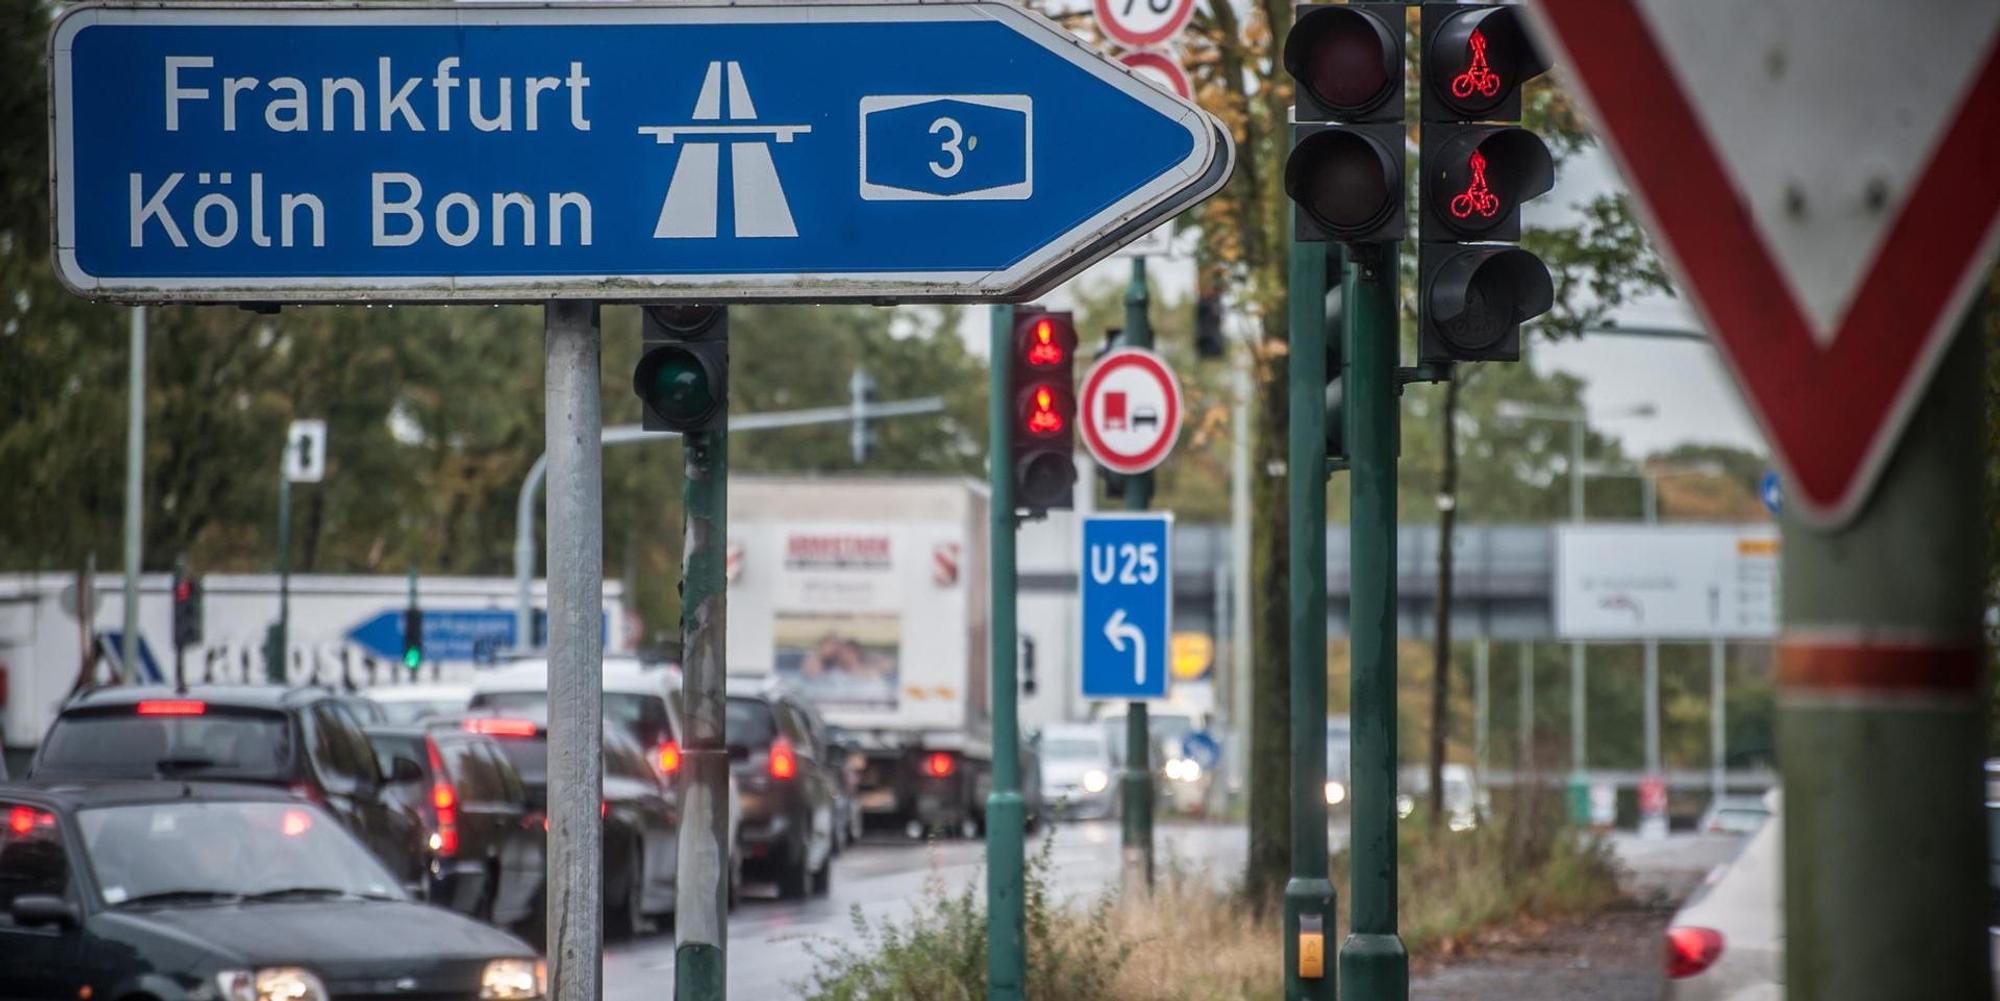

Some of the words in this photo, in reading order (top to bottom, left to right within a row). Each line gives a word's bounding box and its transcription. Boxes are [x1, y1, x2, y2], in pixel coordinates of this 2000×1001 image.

[165, 56, 591, 132] Frankfurt
[928, 117, 964, 178] 3
[129, 172, 325, 248] Köln
[371, 172, 593, 247] Bonn
